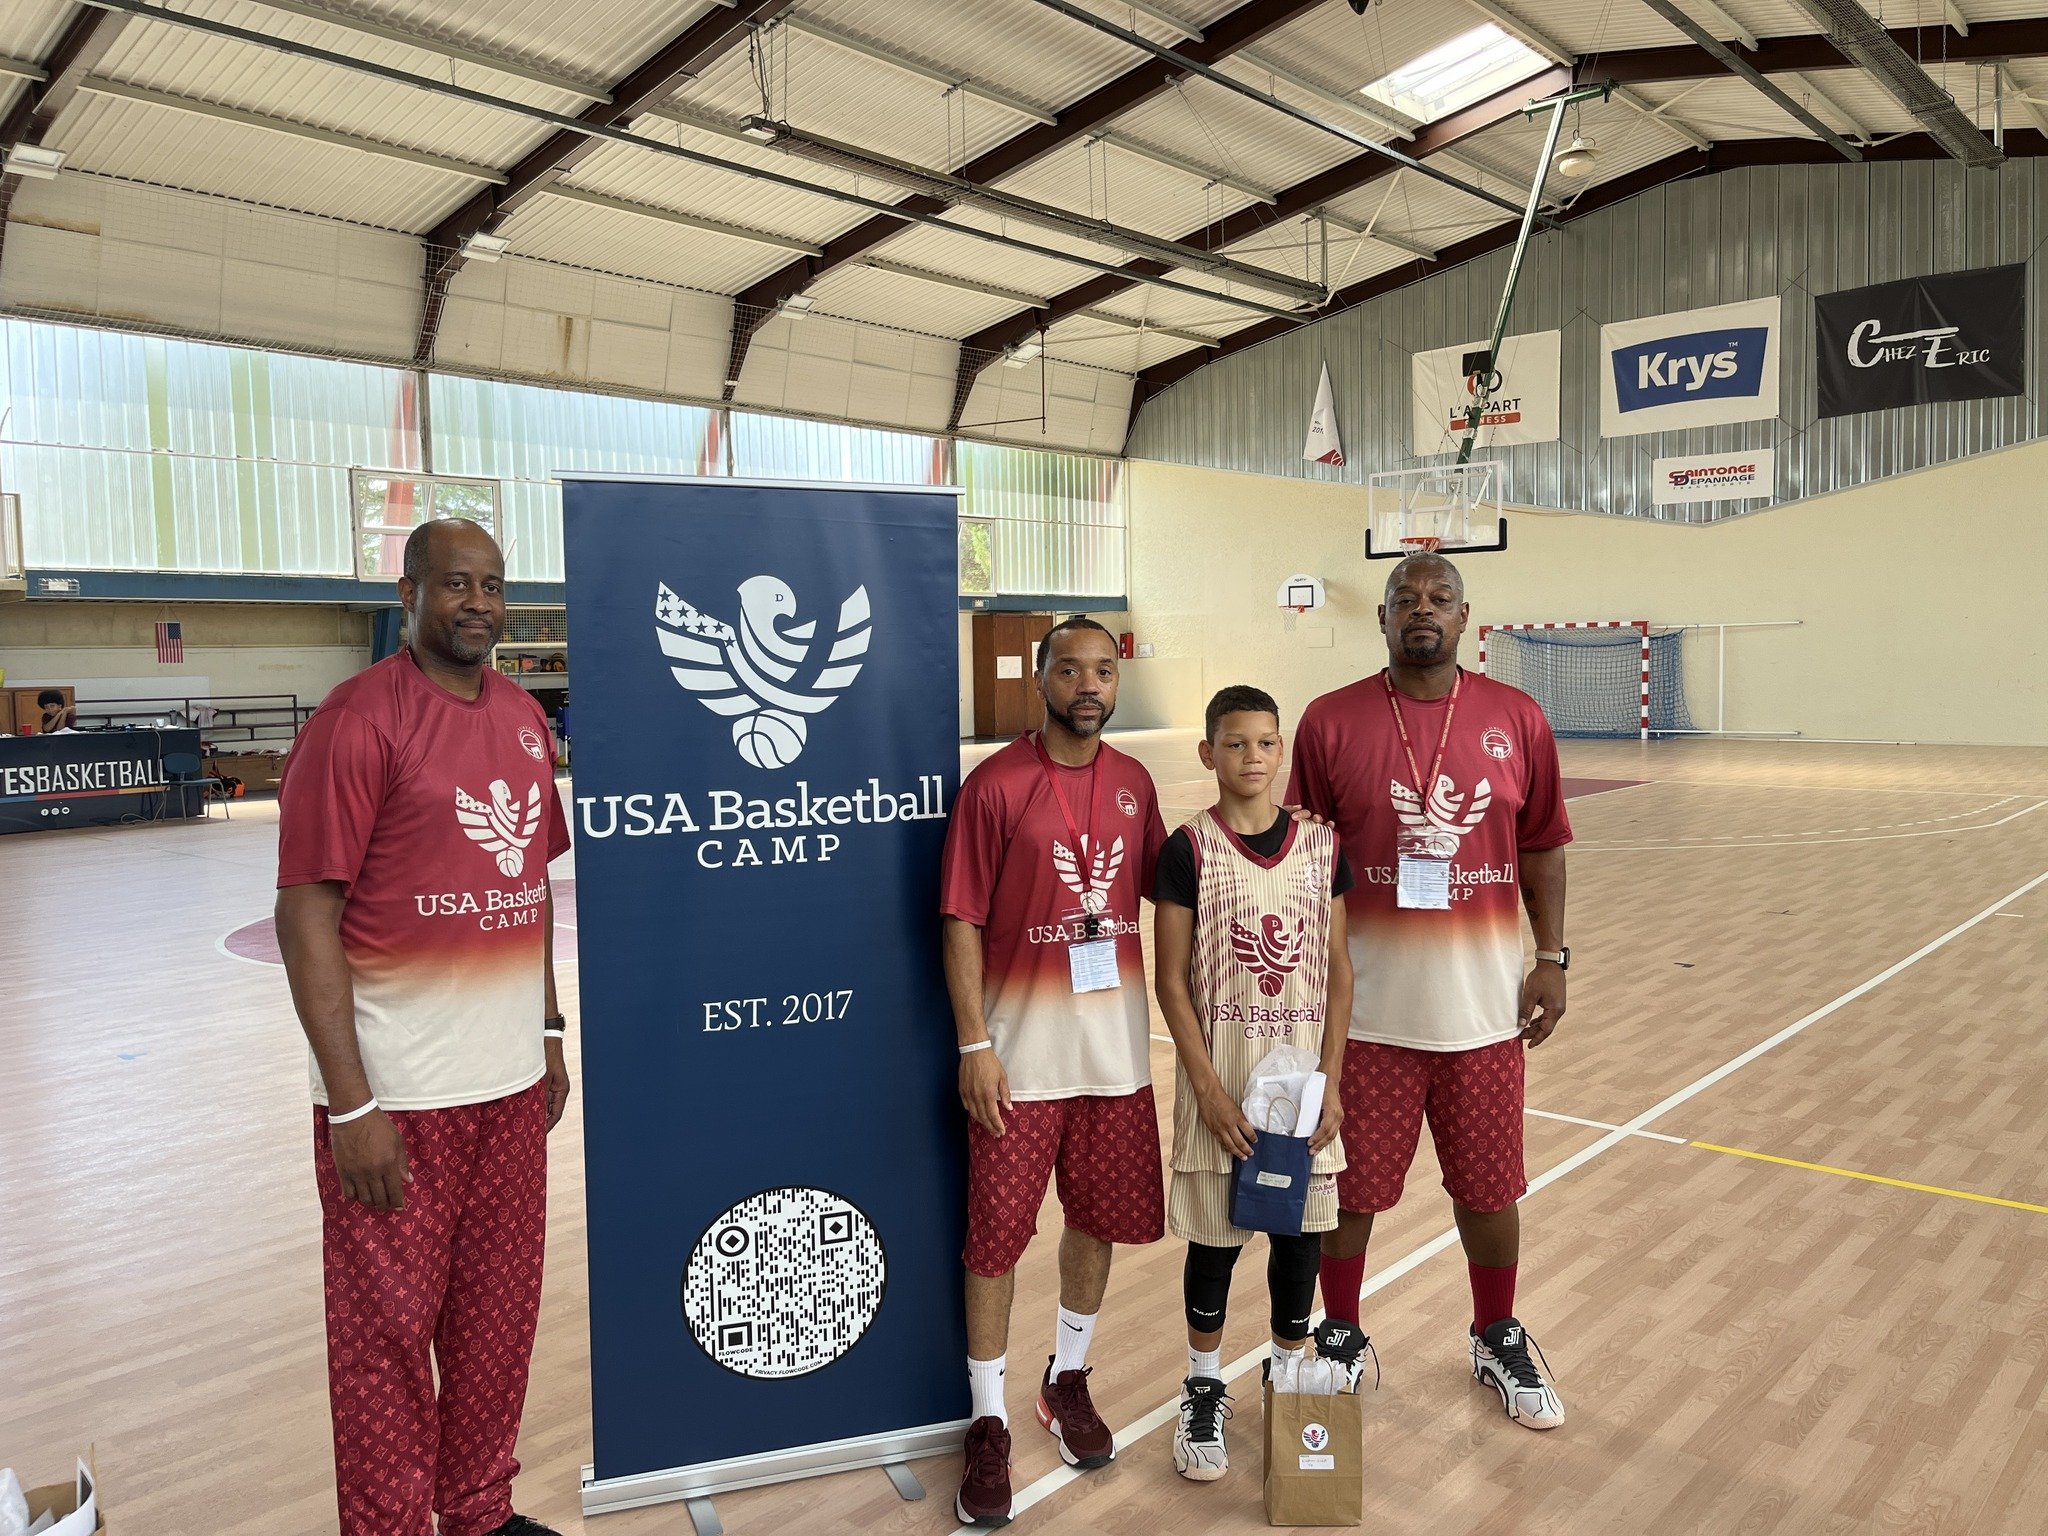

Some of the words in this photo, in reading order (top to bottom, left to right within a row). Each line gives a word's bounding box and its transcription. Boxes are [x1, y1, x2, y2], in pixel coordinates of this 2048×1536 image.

[1638, 350, 1738, 391] Krys
[1449, 398, 1521, 418] L'APART
[1668, 464, 1757, 483] SAINTONGE
[1673, 474, 1756, 487] DEPANNAGE
[775, 593, 784, 602] D
[577, 793, 699, 838] USA
[708, 775, 947, 831] Basketball
[697, 834, 840, 868] CAMP
[1448, 863, 1514, 885] sketball
[415, 892, 481, 916] USA
[1448, 888, 1474, 901] MP
[479, 908, 539, 931] CAMP
[1027, 925, 1070, 944] USA
[702, 998, 772, 1032] EST.
[782, 990, 853, 1025] 2017
[1244, 1024, 1293, 1039] CAMP
[718, 1347, 753, 1357] FLOWCODE
[755, 1360, 823, 1376] PRIVACY.FLOWCODE.COM
